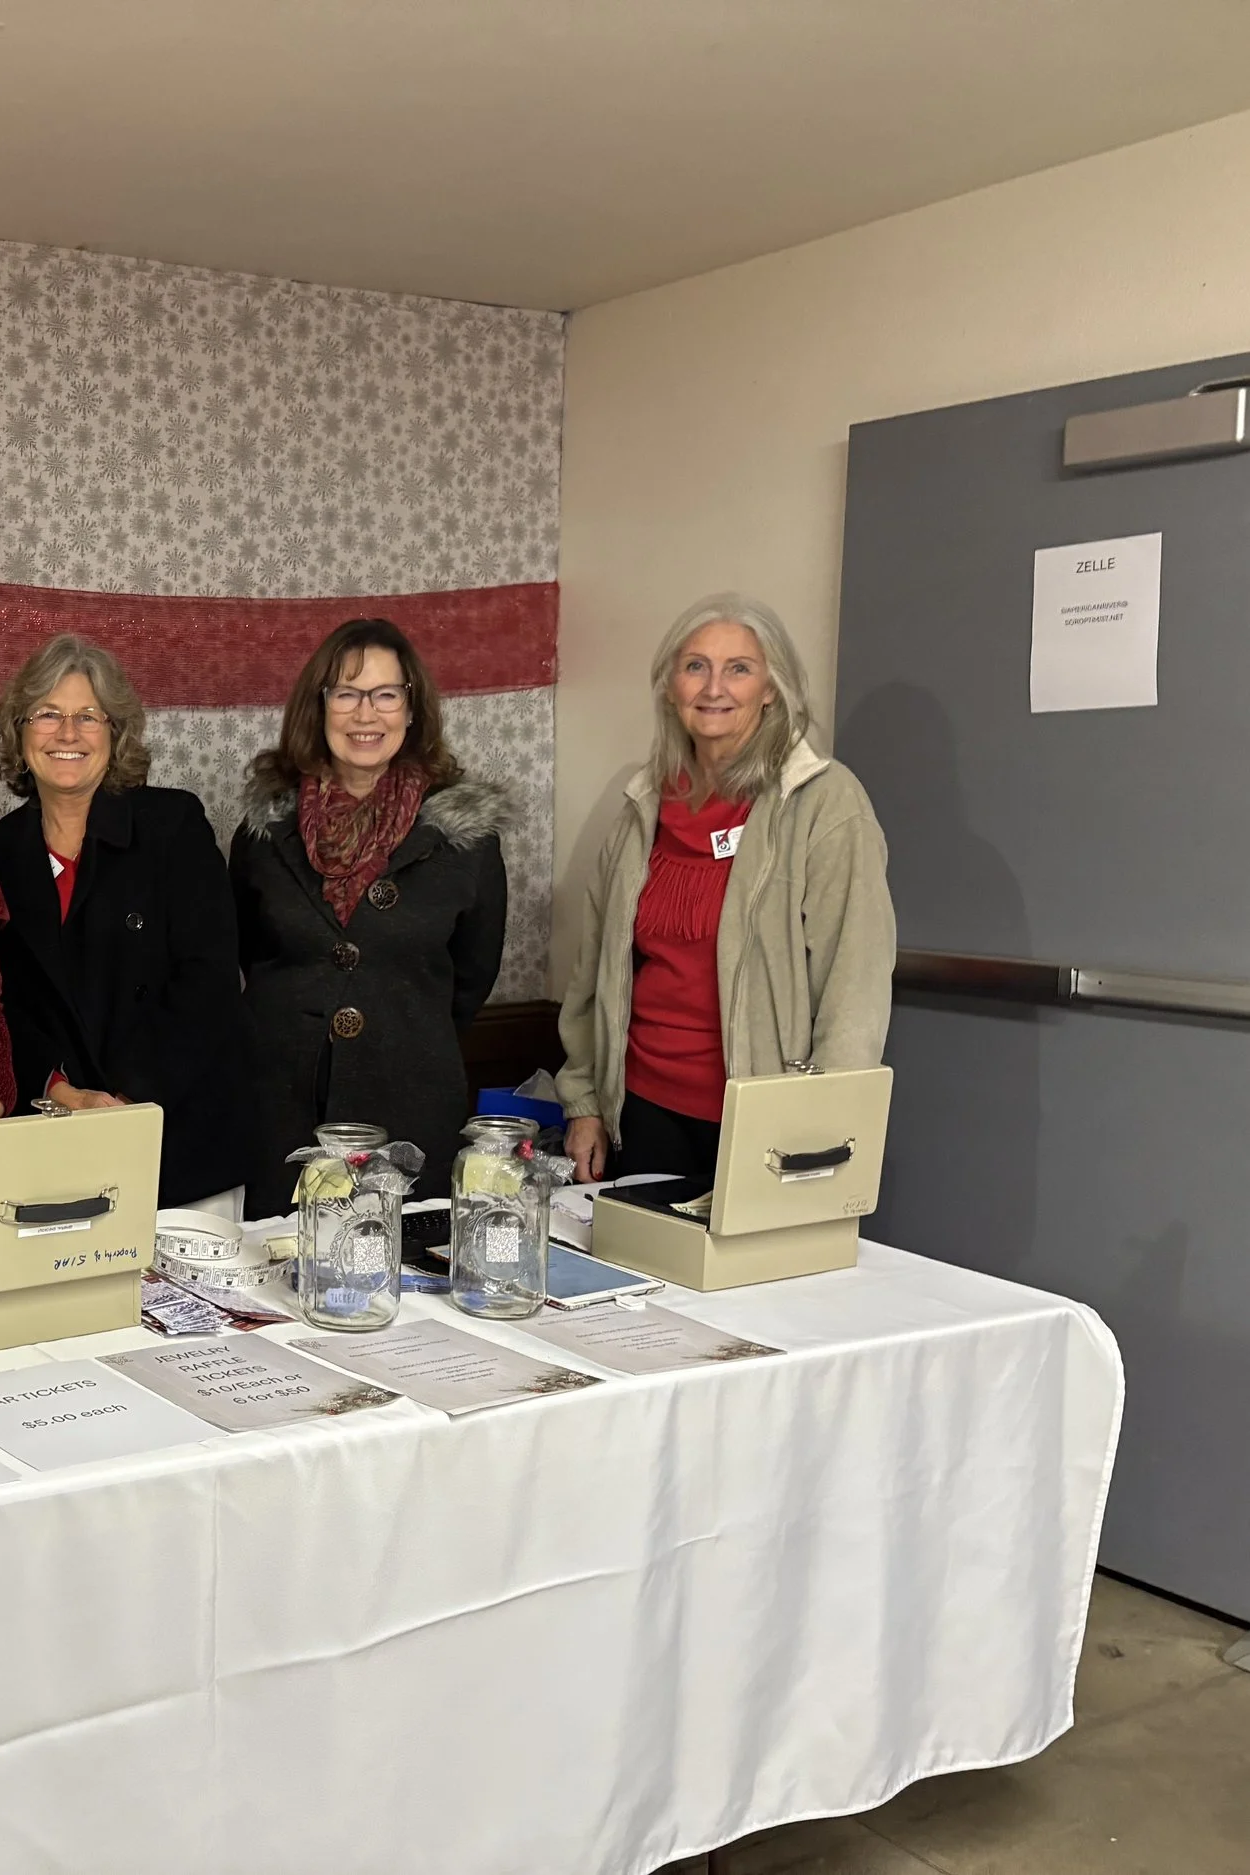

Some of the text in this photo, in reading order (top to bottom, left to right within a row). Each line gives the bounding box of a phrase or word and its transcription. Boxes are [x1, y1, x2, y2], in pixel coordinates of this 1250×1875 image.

[1076, 557, 1116, 574] ZELLE
[94, 1250, 101, 1262] of
[105, 1247, 137, 1262] Property
[155, 1345, 230, 1364] JEWELRY
[179, 1356, 247, 1373] RAFFLE
[192, 1365, 268, 1383] TICKETS
[18, 1379, 97, 1400] TICKETS
[197, 1373, 303, 1397] $10/Each or
[233, 1385, 311, 1405] 6 for $50
[22, 1403, 128, 1429] $5.00 each
